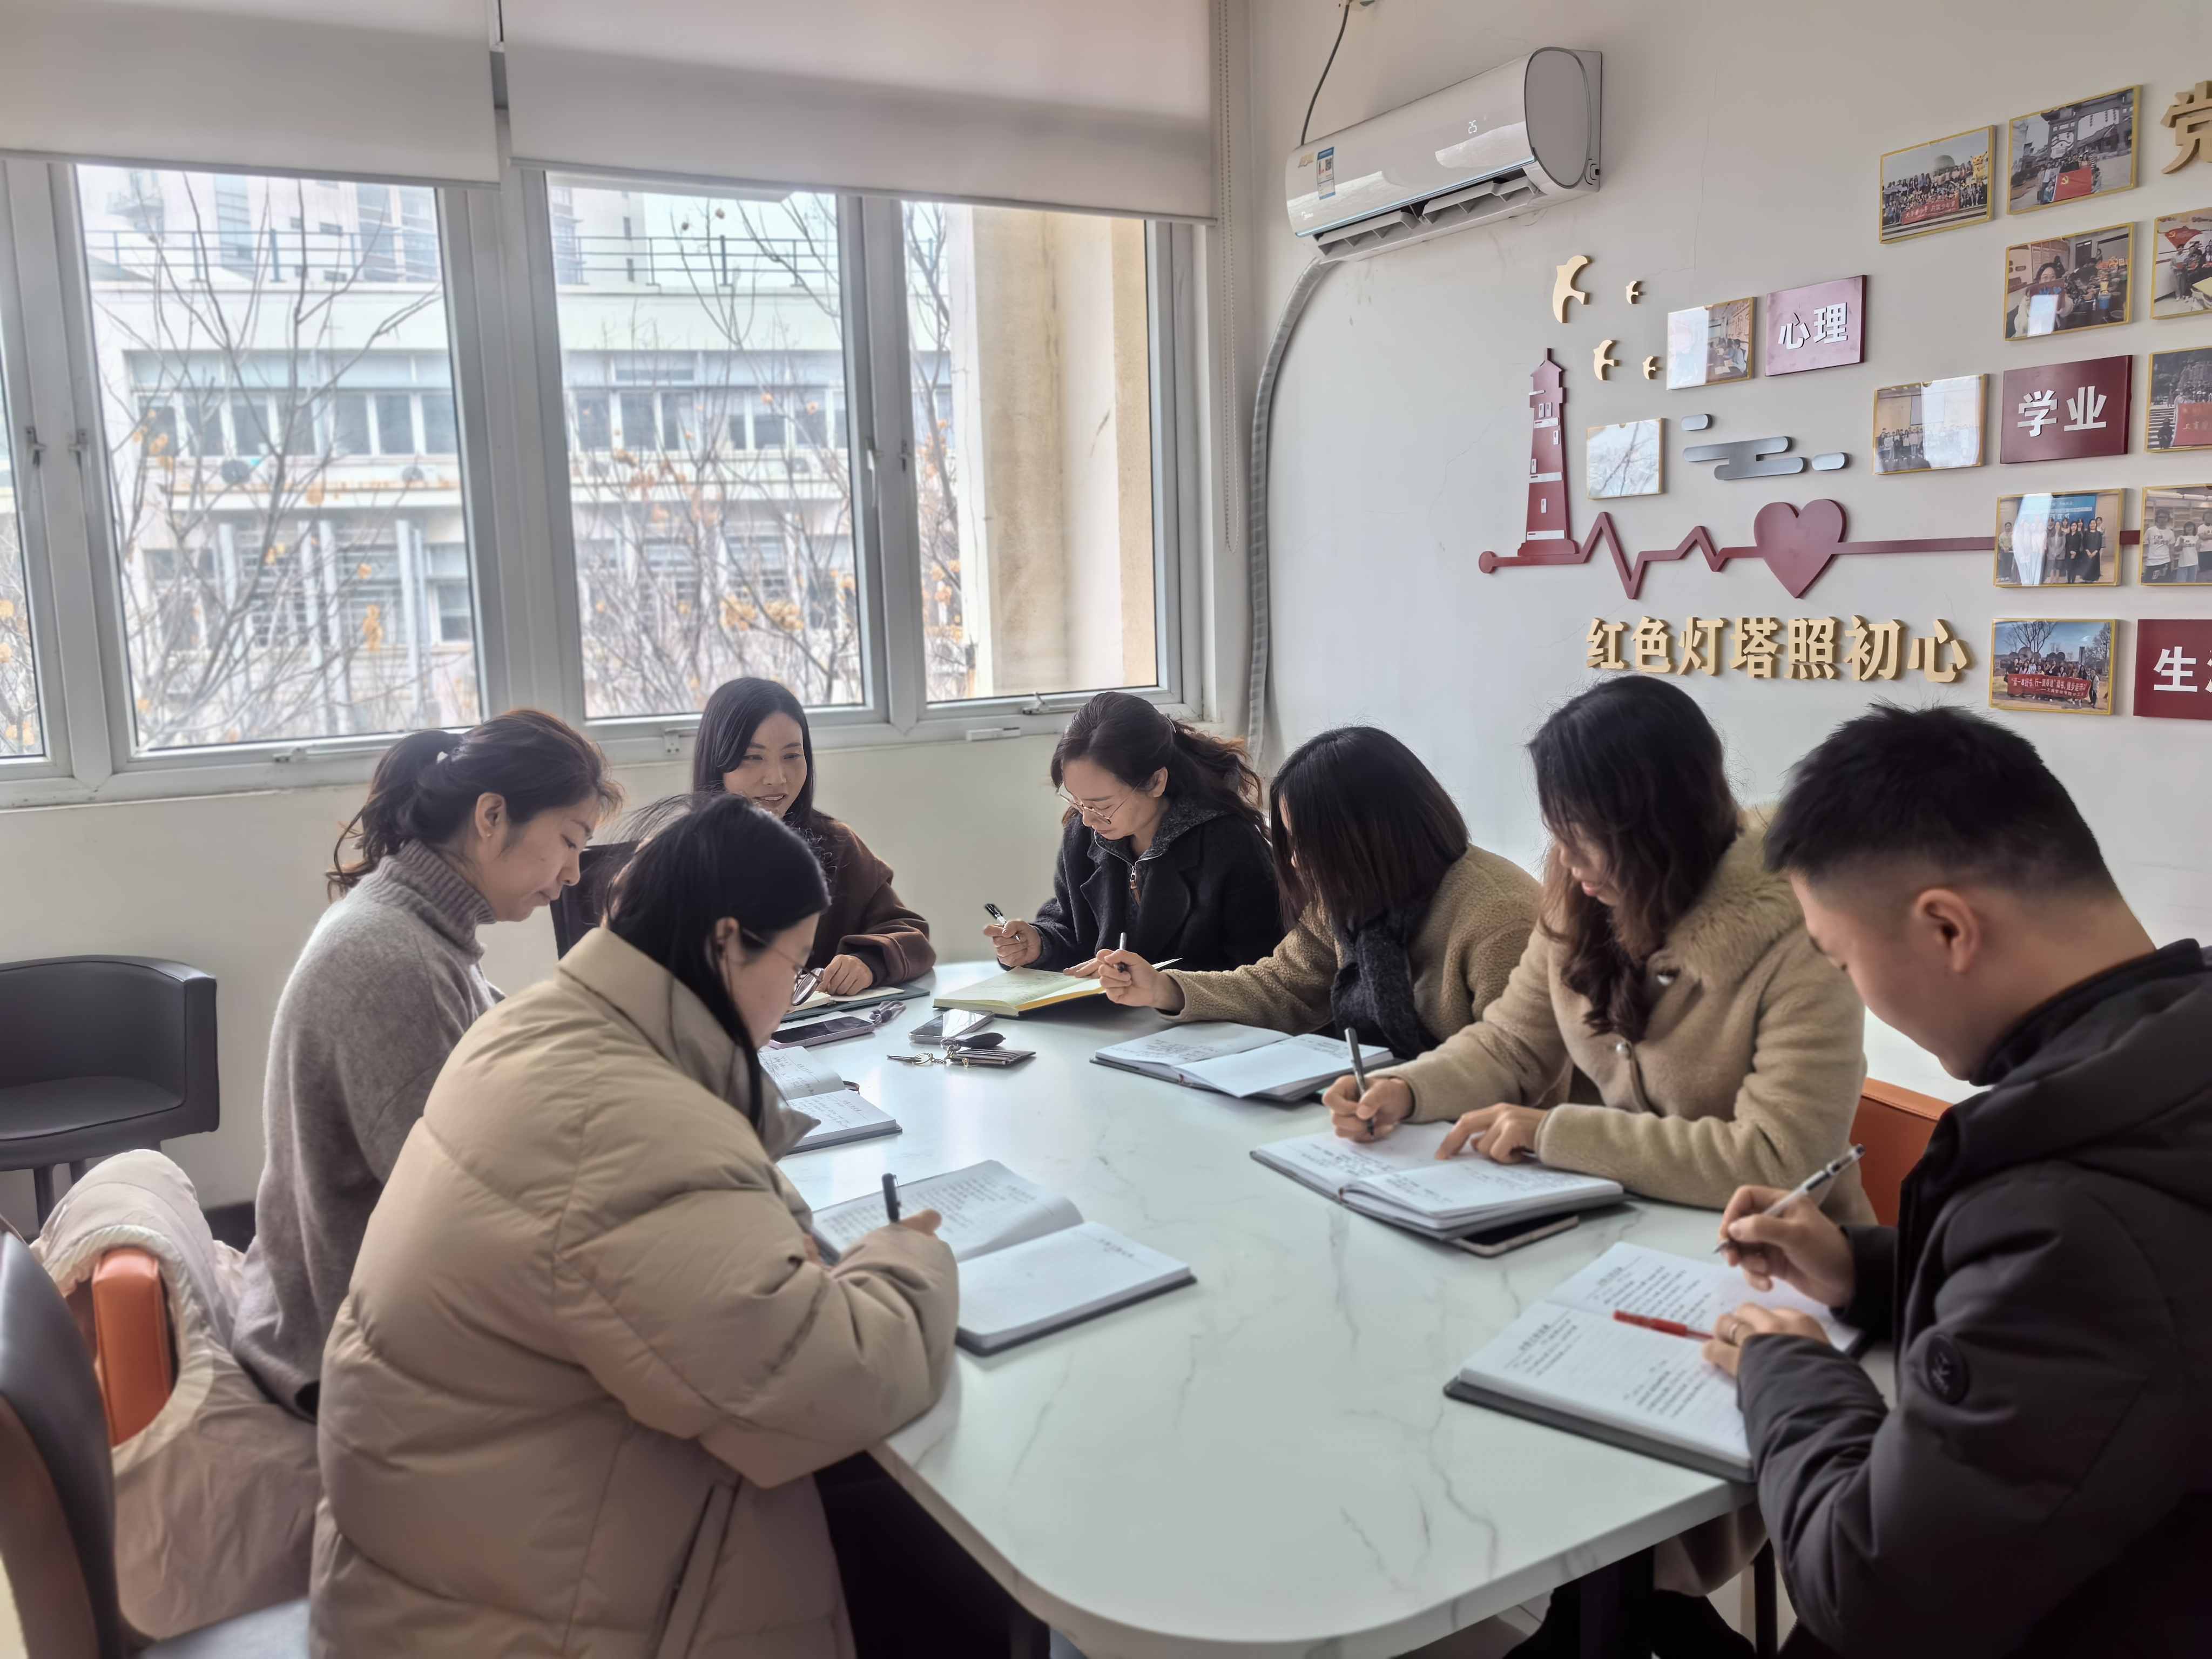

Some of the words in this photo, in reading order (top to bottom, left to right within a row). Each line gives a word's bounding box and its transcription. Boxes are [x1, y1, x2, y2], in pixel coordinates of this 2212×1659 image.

[1468, 120, 1477, 134] 25
[1778, 302, 1848, 350] 心理
[2017, 386, 2107, 437] 学业
[1586, 615, 1968, 682] 红色灯塔照初心
[2153, 646, 2212, 693] 生
